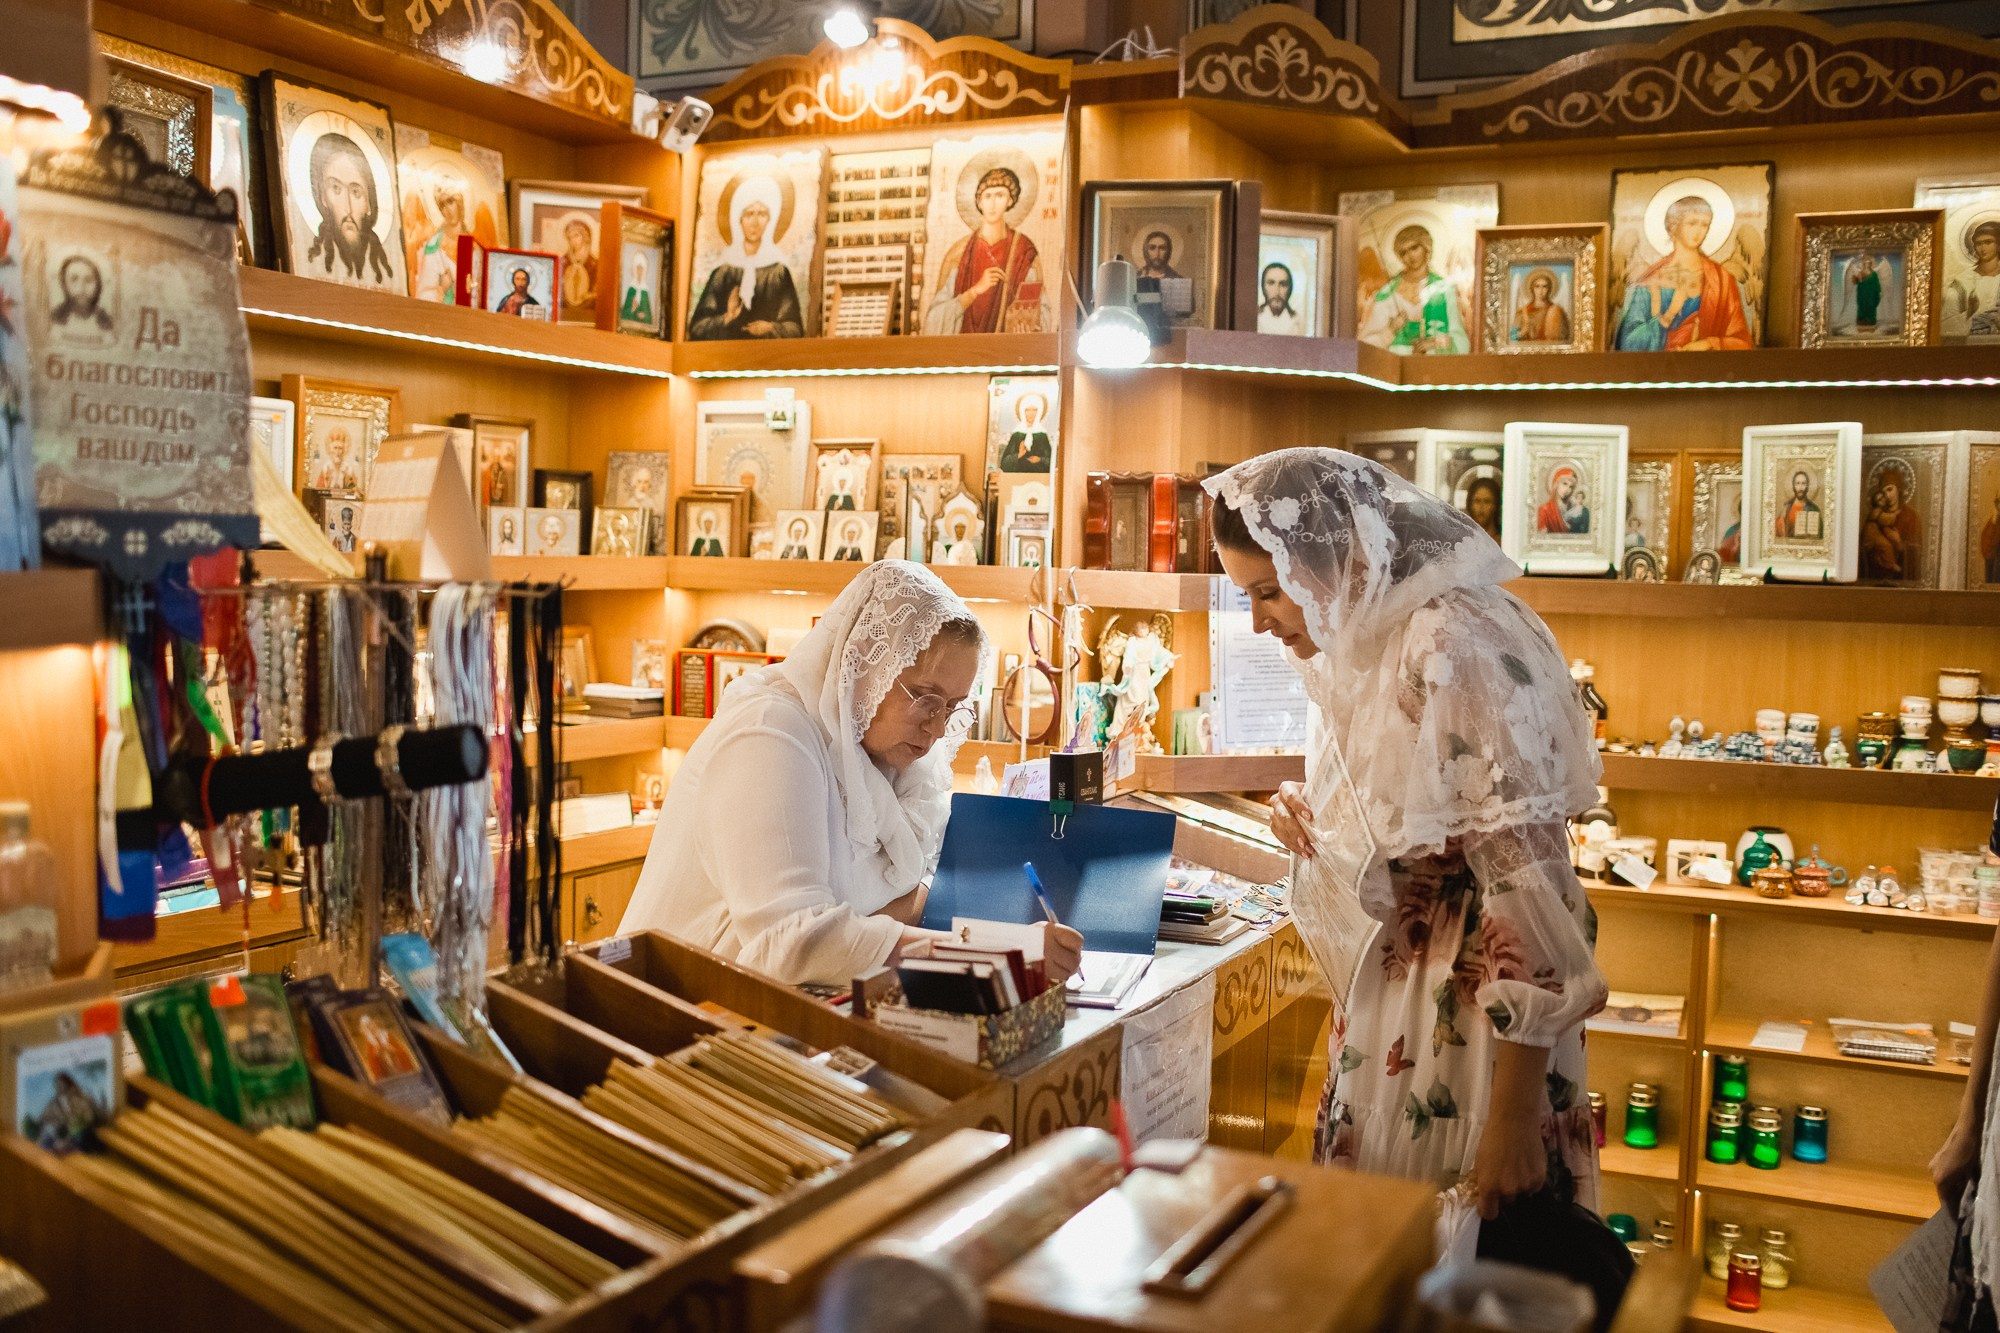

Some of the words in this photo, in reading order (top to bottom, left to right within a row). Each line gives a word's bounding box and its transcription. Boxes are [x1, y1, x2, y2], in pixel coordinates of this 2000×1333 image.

[134, 306, 181, 352] Да
[45, 352, 229, 393] благословит
[70, 391, 197, 435] Господь
[77, 437, 137, 461] ваш
[140, 439, 197, 467] дом
